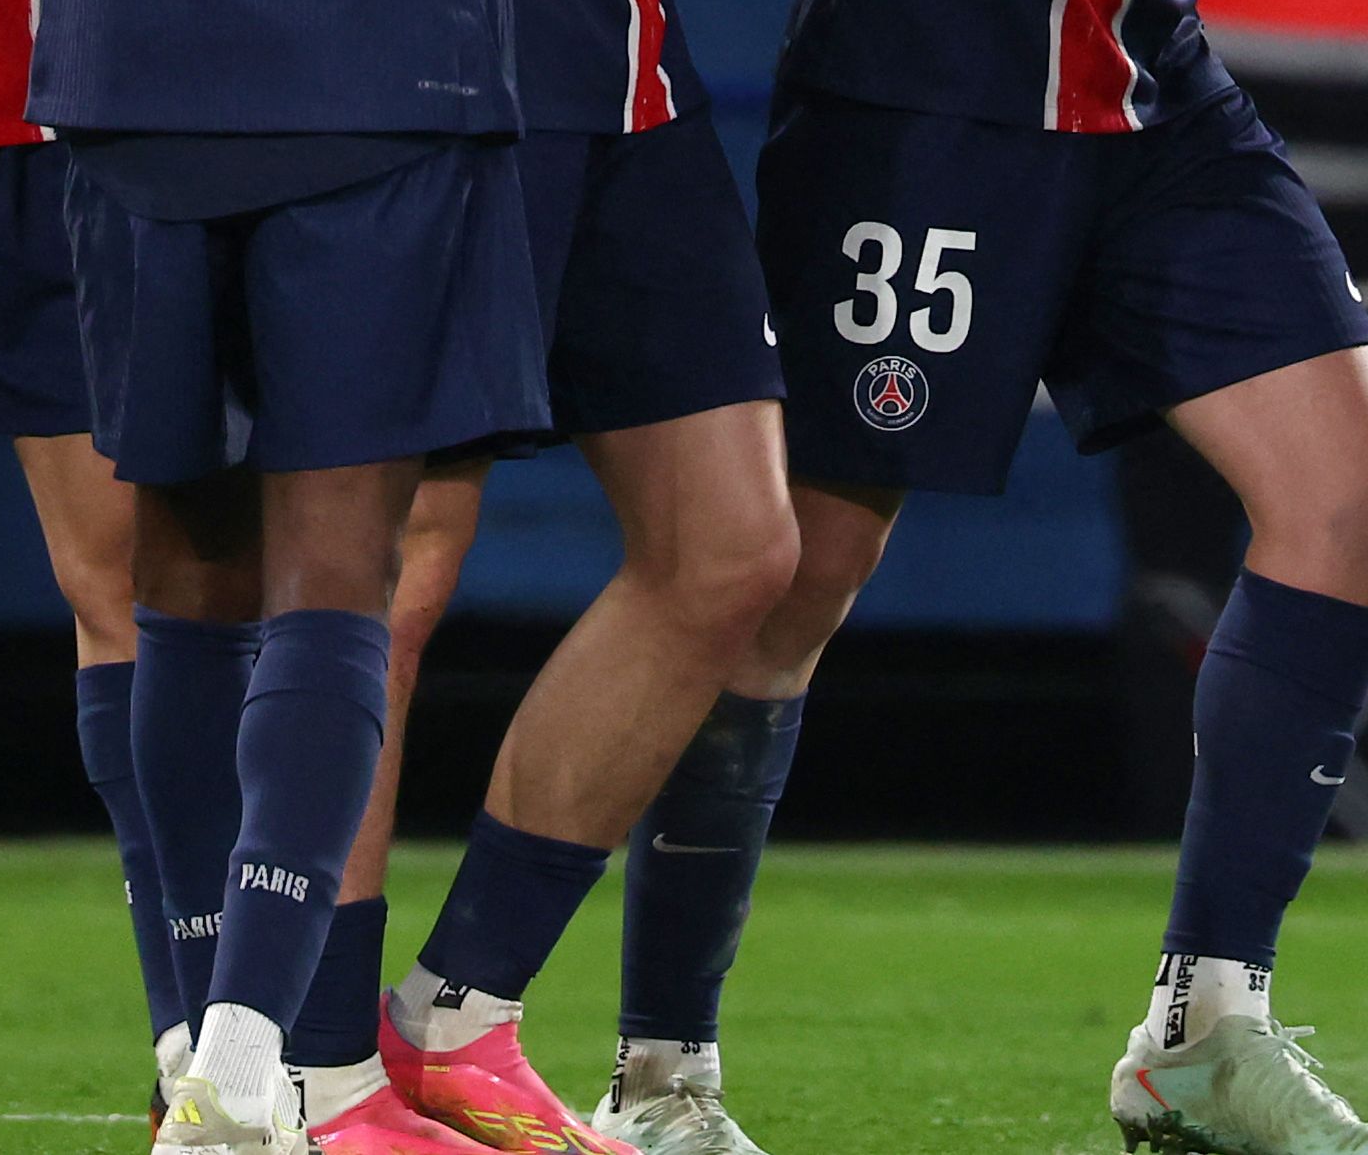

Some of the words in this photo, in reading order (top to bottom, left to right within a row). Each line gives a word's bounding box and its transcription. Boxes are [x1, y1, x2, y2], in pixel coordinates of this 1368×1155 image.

[834, 221, 977, 353] 35
[868, 360, 917, 379] PARIS
[239, 863, 310, 903] PARIS
[1249, 972, 1266, 992] 35
